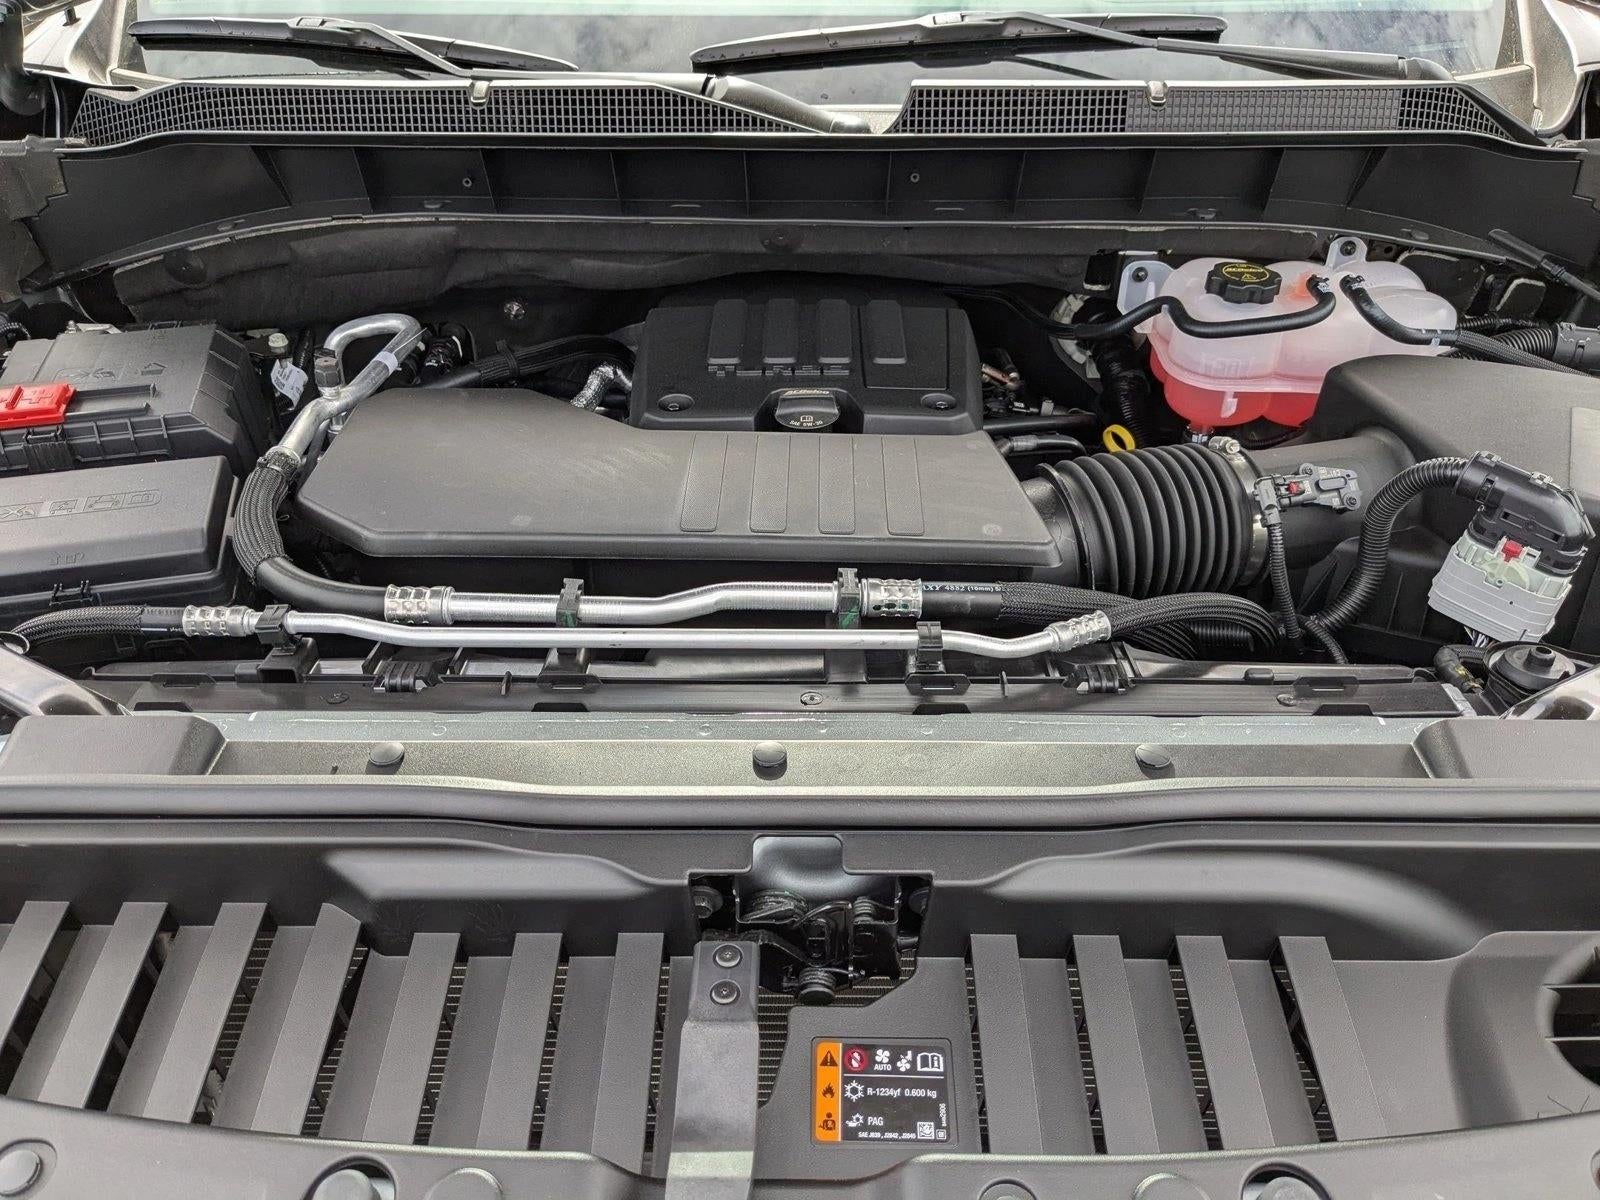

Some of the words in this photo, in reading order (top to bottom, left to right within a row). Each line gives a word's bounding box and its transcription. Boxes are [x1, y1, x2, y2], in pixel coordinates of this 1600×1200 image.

[874, 1063, 892, 1071] AUTO
[867, 1087, 901, 1098] R-1234yf
[904, 1088, 926, 1097] 0.600
[927, 1088, 937, 1099] kg
[867, 1117, 884, 1126] PAG
